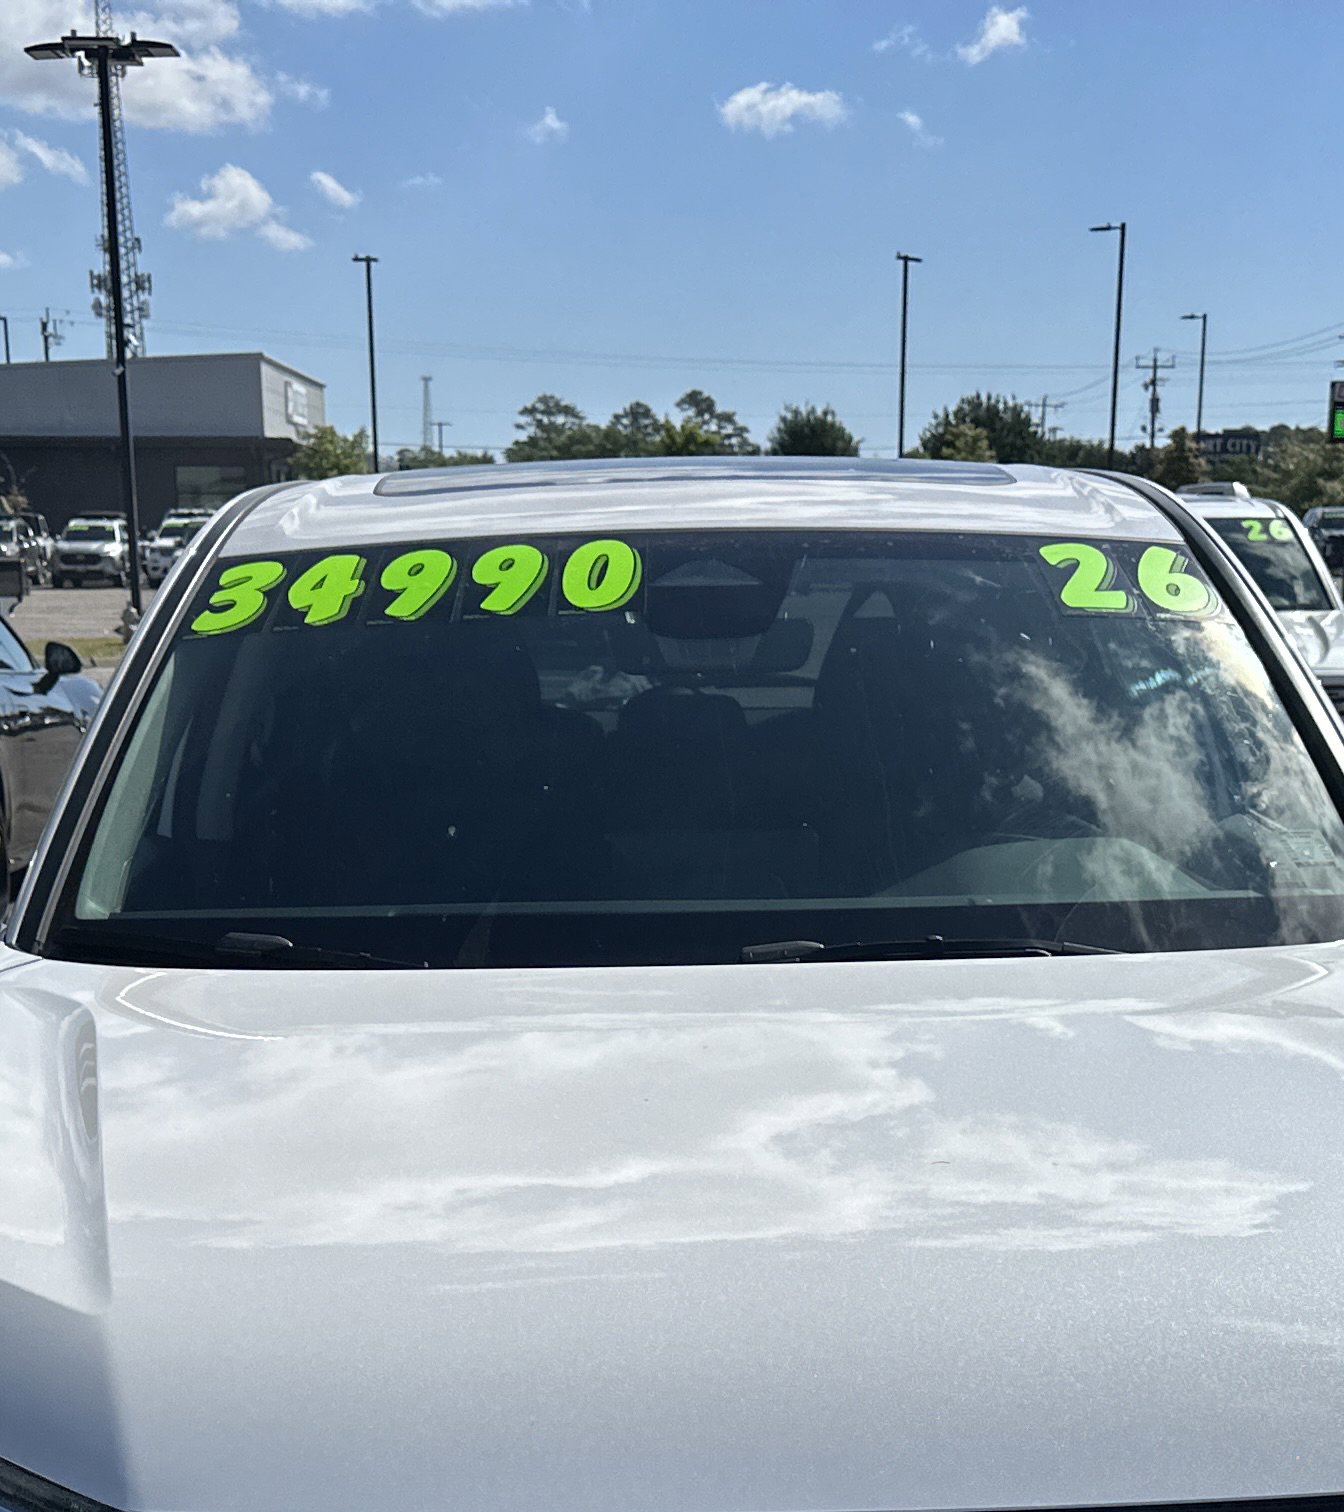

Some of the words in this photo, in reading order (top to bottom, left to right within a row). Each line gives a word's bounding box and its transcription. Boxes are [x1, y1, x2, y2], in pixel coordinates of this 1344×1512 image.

[1240, 519, 1292, 541] 26
[190, 538, 643, 637] 34990
[1038, 542, 1220, 617] 26
